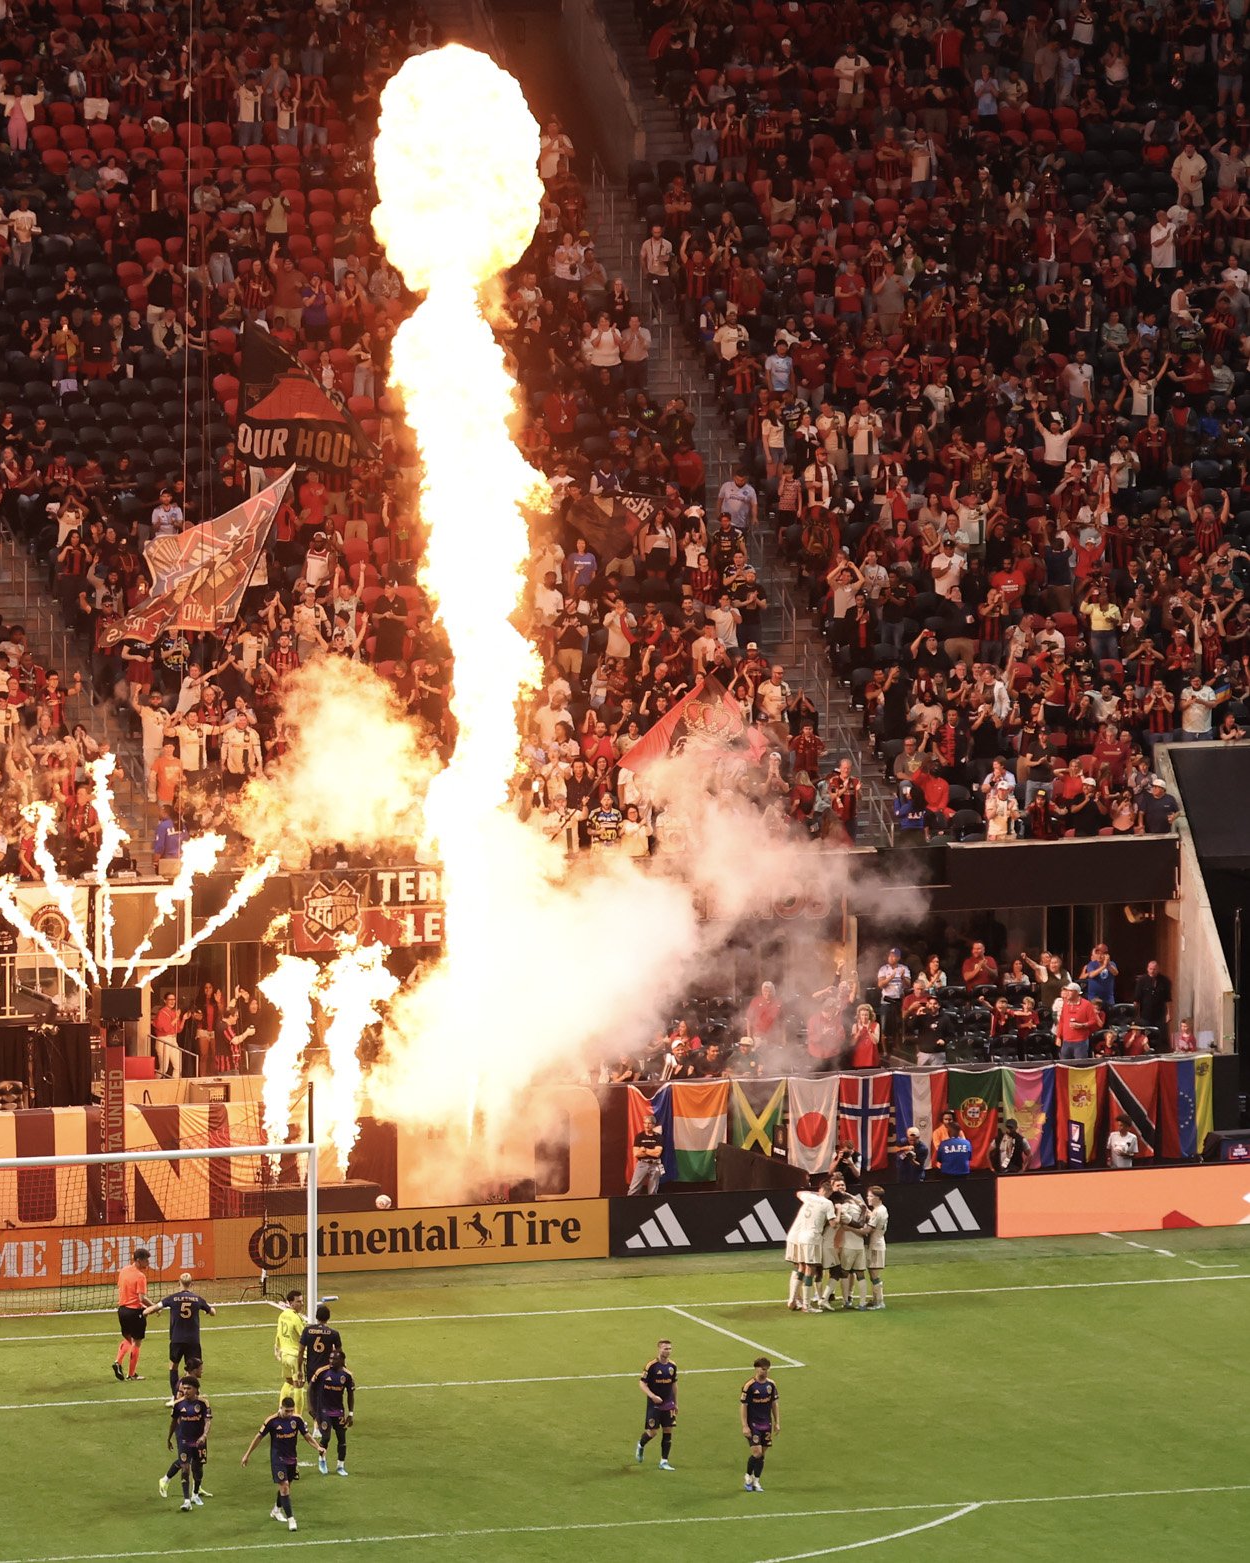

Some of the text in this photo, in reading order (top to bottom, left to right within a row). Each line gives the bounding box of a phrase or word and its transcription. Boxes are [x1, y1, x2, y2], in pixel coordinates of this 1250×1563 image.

[237, 423, 351, 468] OUR HOU
[377, 871, 440, 902] TER
[406, 912, 442, 943] LE
[108, 1069, 124, 1201] ATLATA UNITED
[59, 1231, 203, 1276] DEPOT
[250, 1210, 582, 1270] Continental Tire
[180, 1302, 192, 1319] 5
[313, 1336, 325, 1353] 6
